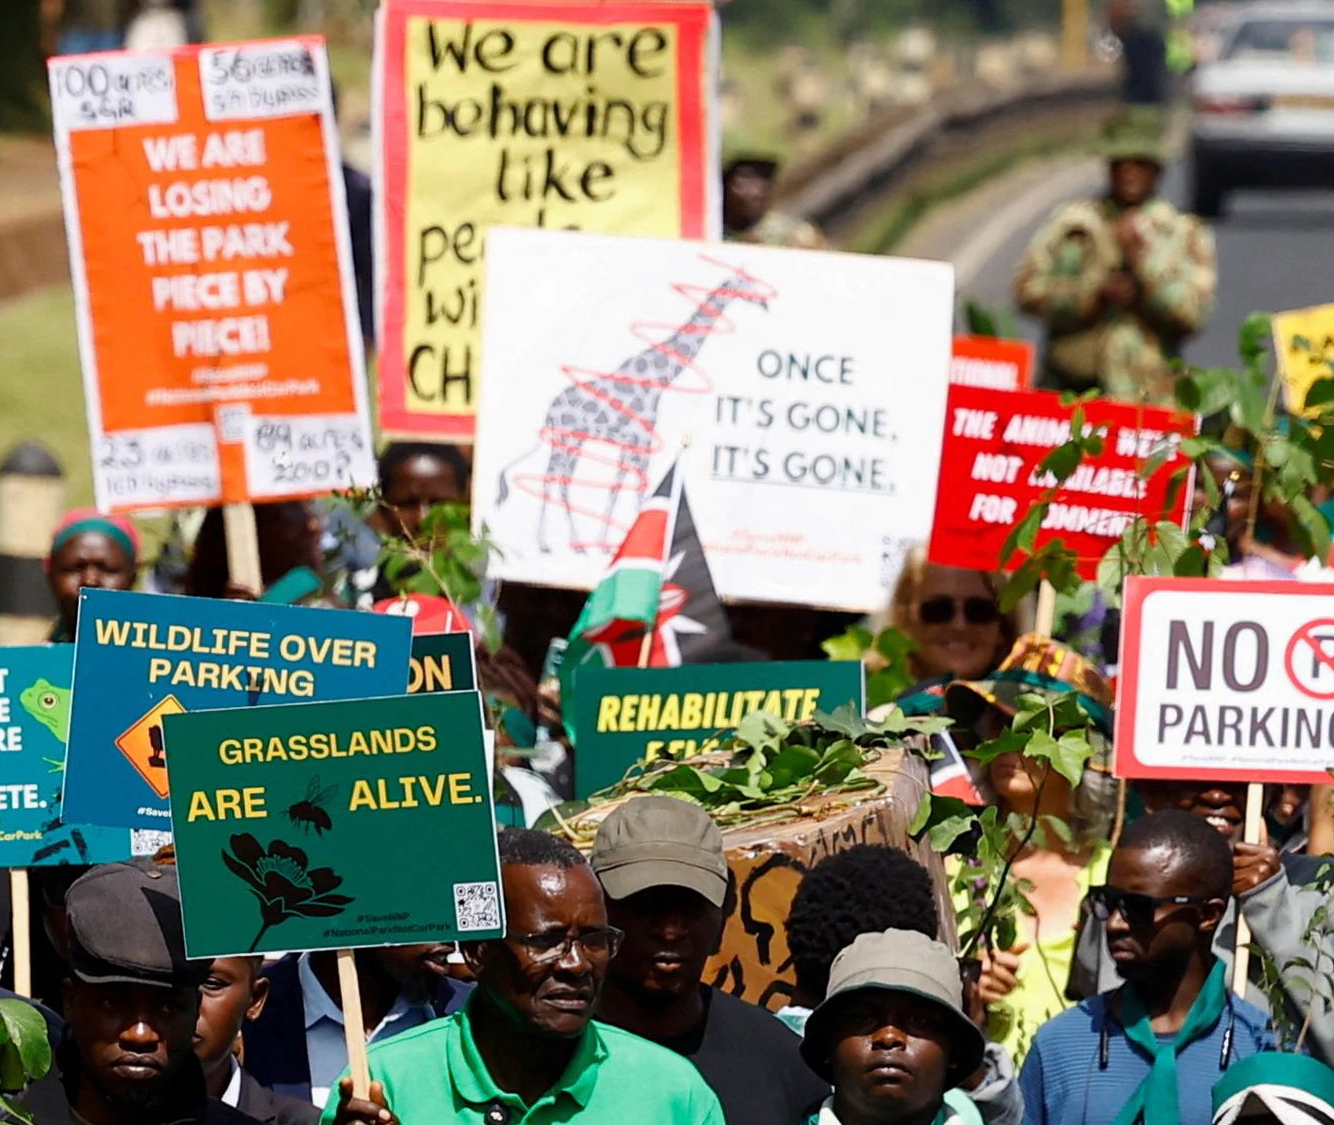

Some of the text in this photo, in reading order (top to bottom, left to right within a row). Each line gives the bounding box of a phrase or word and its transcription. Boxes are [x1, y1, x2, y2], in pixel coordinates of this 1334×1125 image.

[426, 20, 669, 80] We are
[416, 80, 669, 162] behaving
[142, 128, 266, 173] WE ARE
[147, 175, 273, 219] LOSING
[493, 148, 616, 203] like
[135, 220, 295, 267] THE PARK
[151, 266, 290, 313] PIECE BY
[756, 349, 857, 386] ONCE
[716, 395, 775, 429] IT'S
[953, 407, 999, 441] THE
[711, 444, 771, 480] IT'S
[970, 450, 1025, 484] NOT
[968, 492, 1018, 525] FOR
[95, 618, 379, 669] WILDLIFE OVER
[1165, 619, 1271, 693] NO
[148, 657, 316, 699] PARKING
[596, 687, 821, 733] REHABILITATE
[218, 726, 438, 766] GRASSLANDS
[186, 772, 483, 823] ARE ALIVE.
